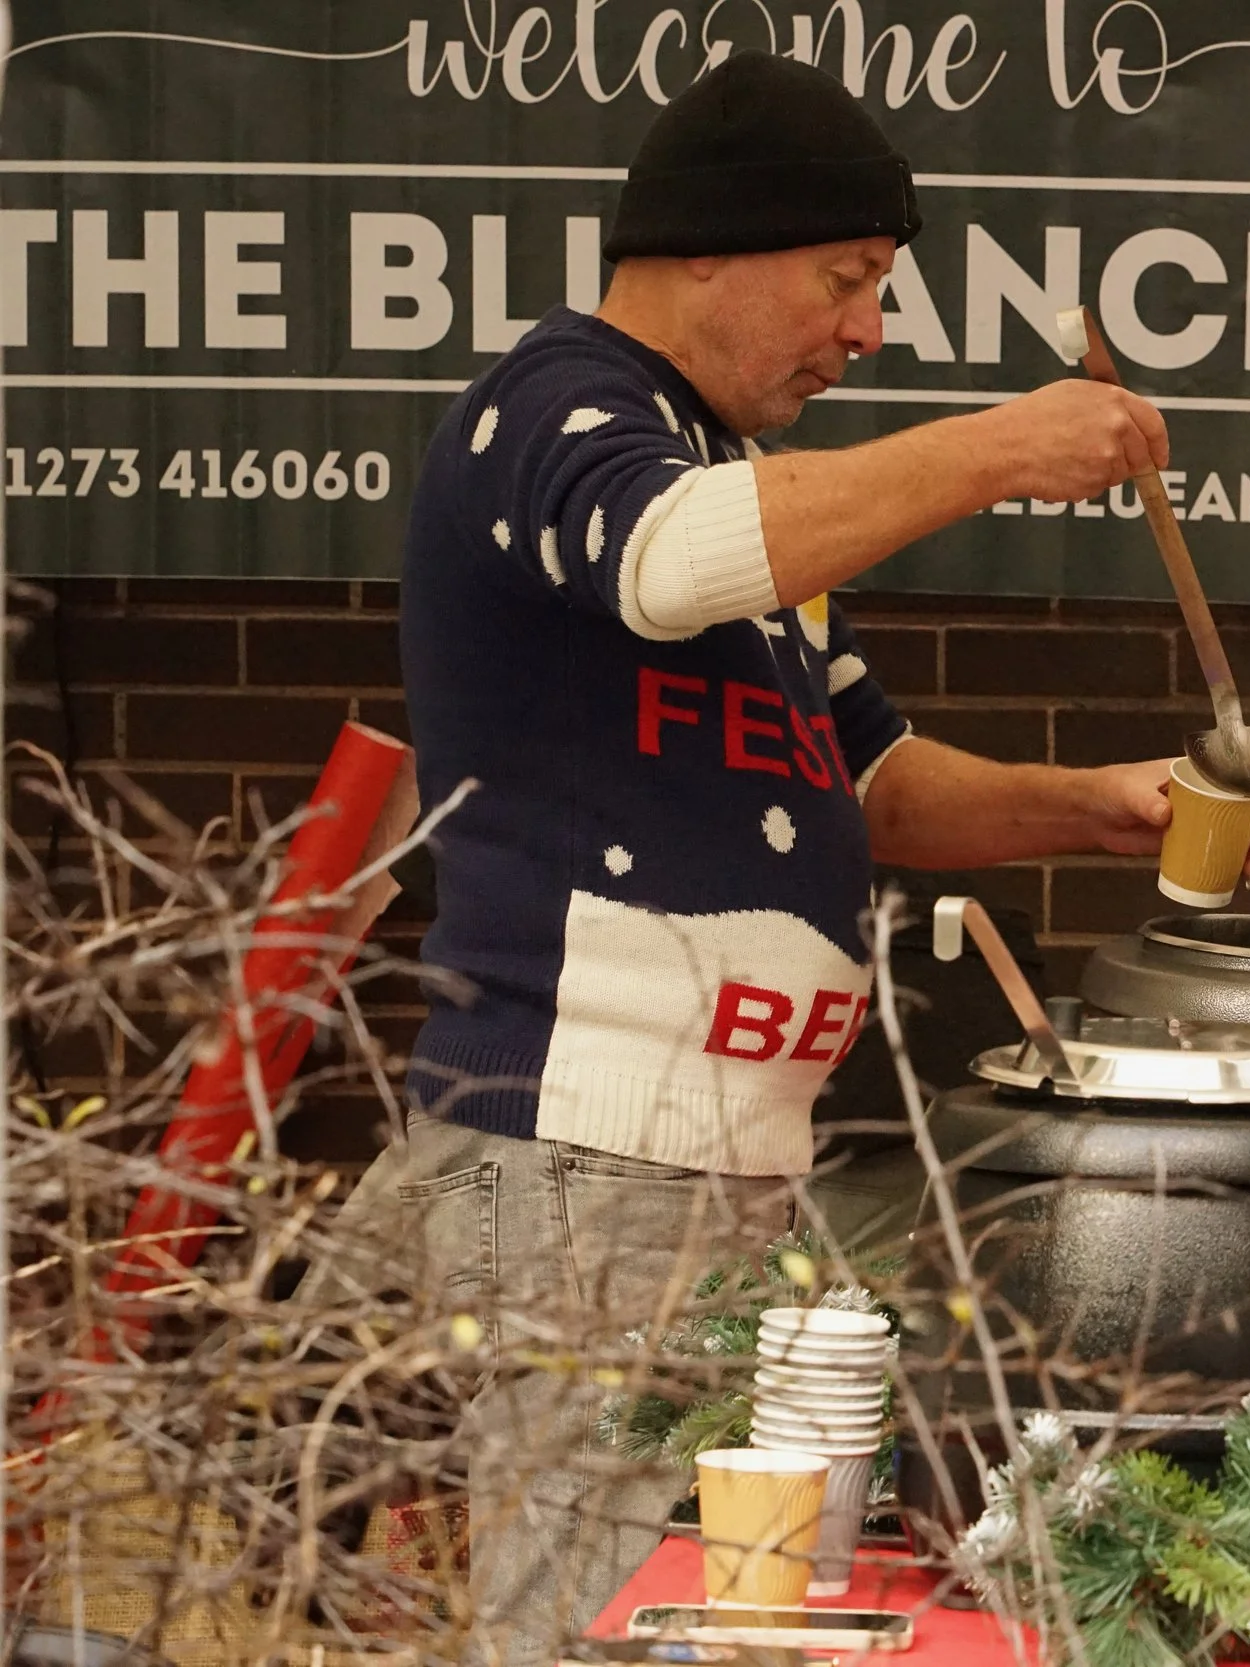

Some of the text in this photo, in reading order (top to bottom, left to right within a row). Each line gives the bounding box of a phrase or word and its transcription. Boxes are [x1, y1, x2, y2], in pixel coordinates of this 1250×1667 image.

[0, 209, 287, 350] THE
[350, 212, 600, 352] BL
[5, 447, 391, 502] 1273 416060
